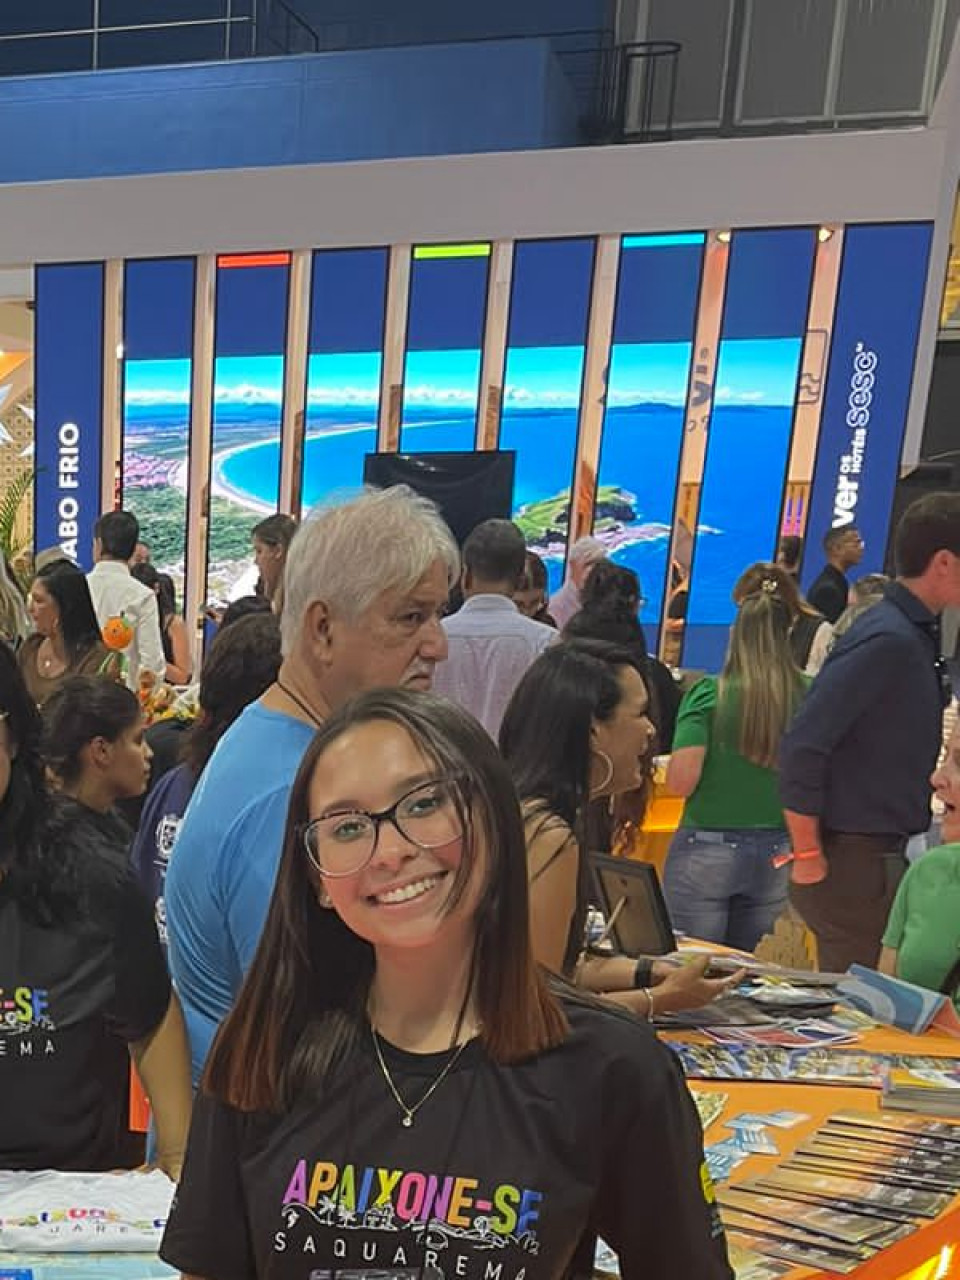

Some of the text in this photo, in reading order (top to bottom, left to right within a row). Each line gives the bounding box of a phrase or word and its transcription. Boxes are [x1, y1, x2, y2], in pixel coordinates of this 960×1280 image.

[846, 351, 879, 428] sesc
[58, 423, 83, 567] ABO FRIO
[282, 1159, 543, 1238] APAIXONE-SE
